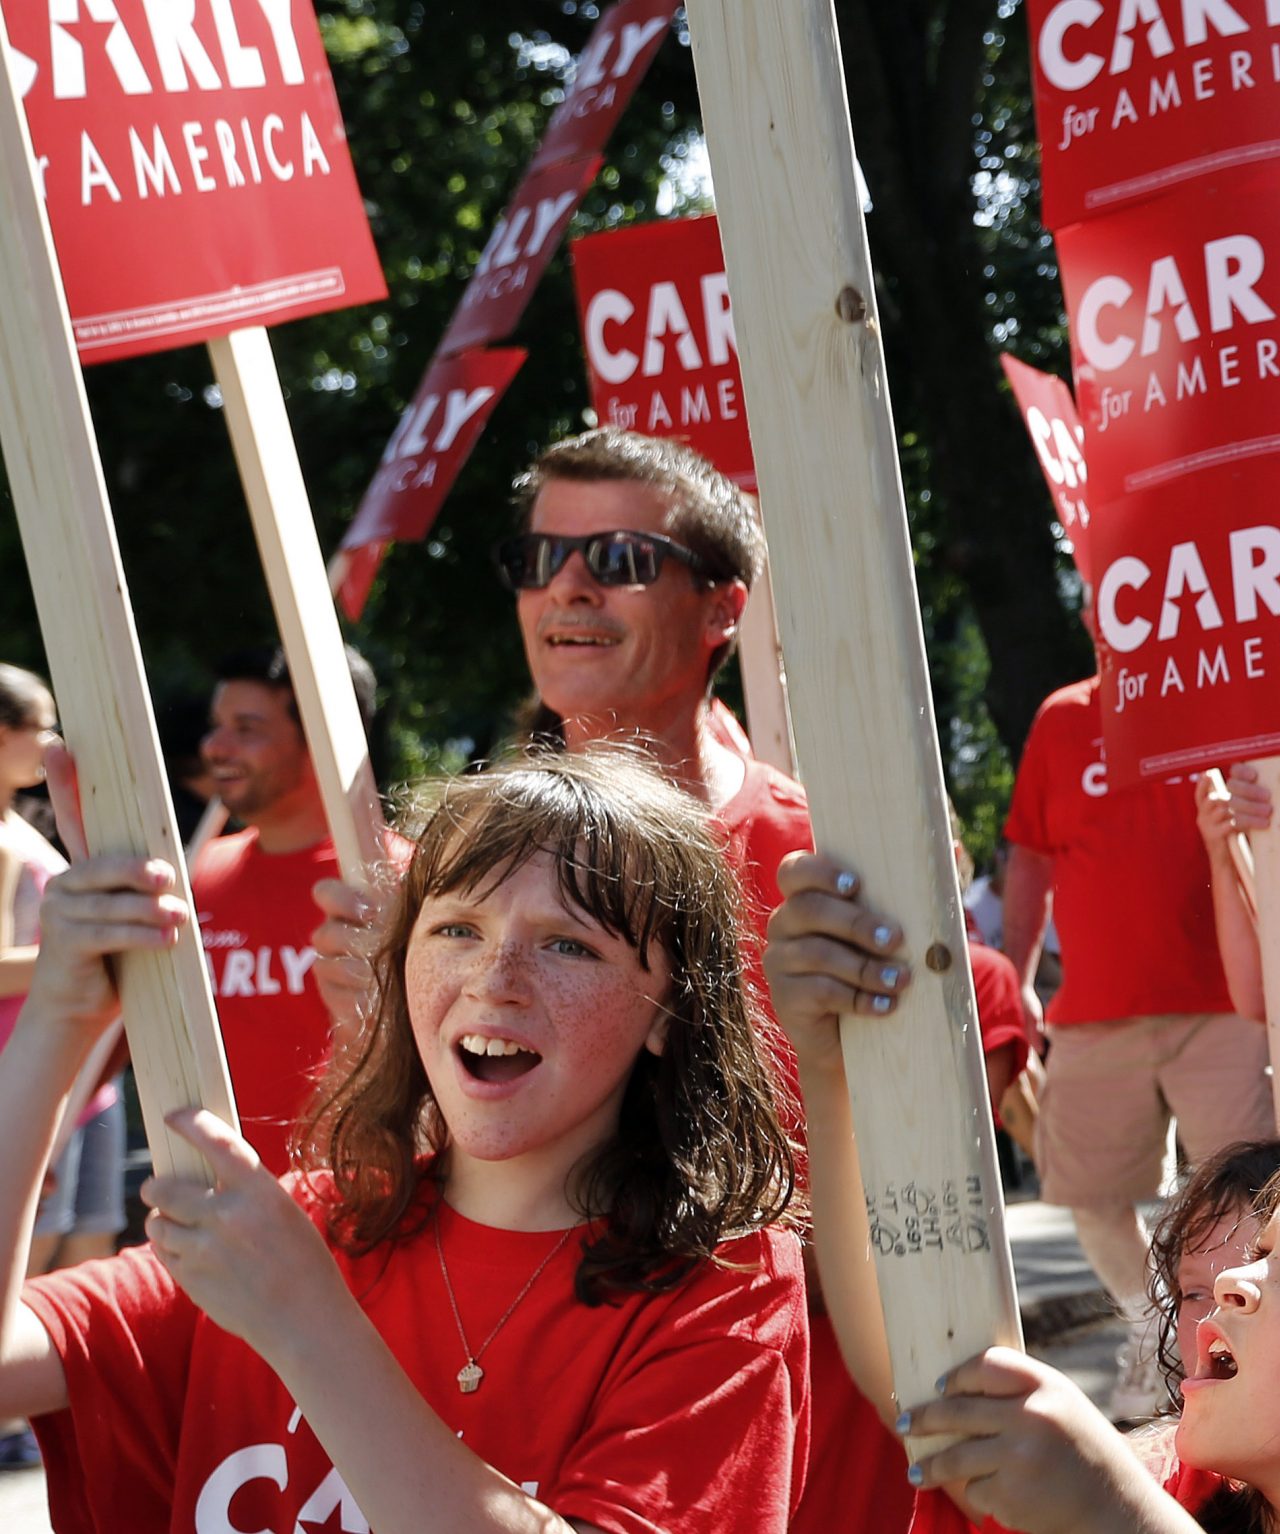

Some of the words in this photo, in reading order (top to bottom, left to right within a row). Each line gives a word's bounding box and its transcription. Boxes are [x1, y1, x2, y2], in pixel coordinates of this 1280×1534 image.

[1058, 105, 1099, 151] for
[80, 110, 331, 206] AMERICA
[585, 271, 738, 385] CAR
[1098, 387, 1132, 432] for
[1114, 668, 1148, 713] for
